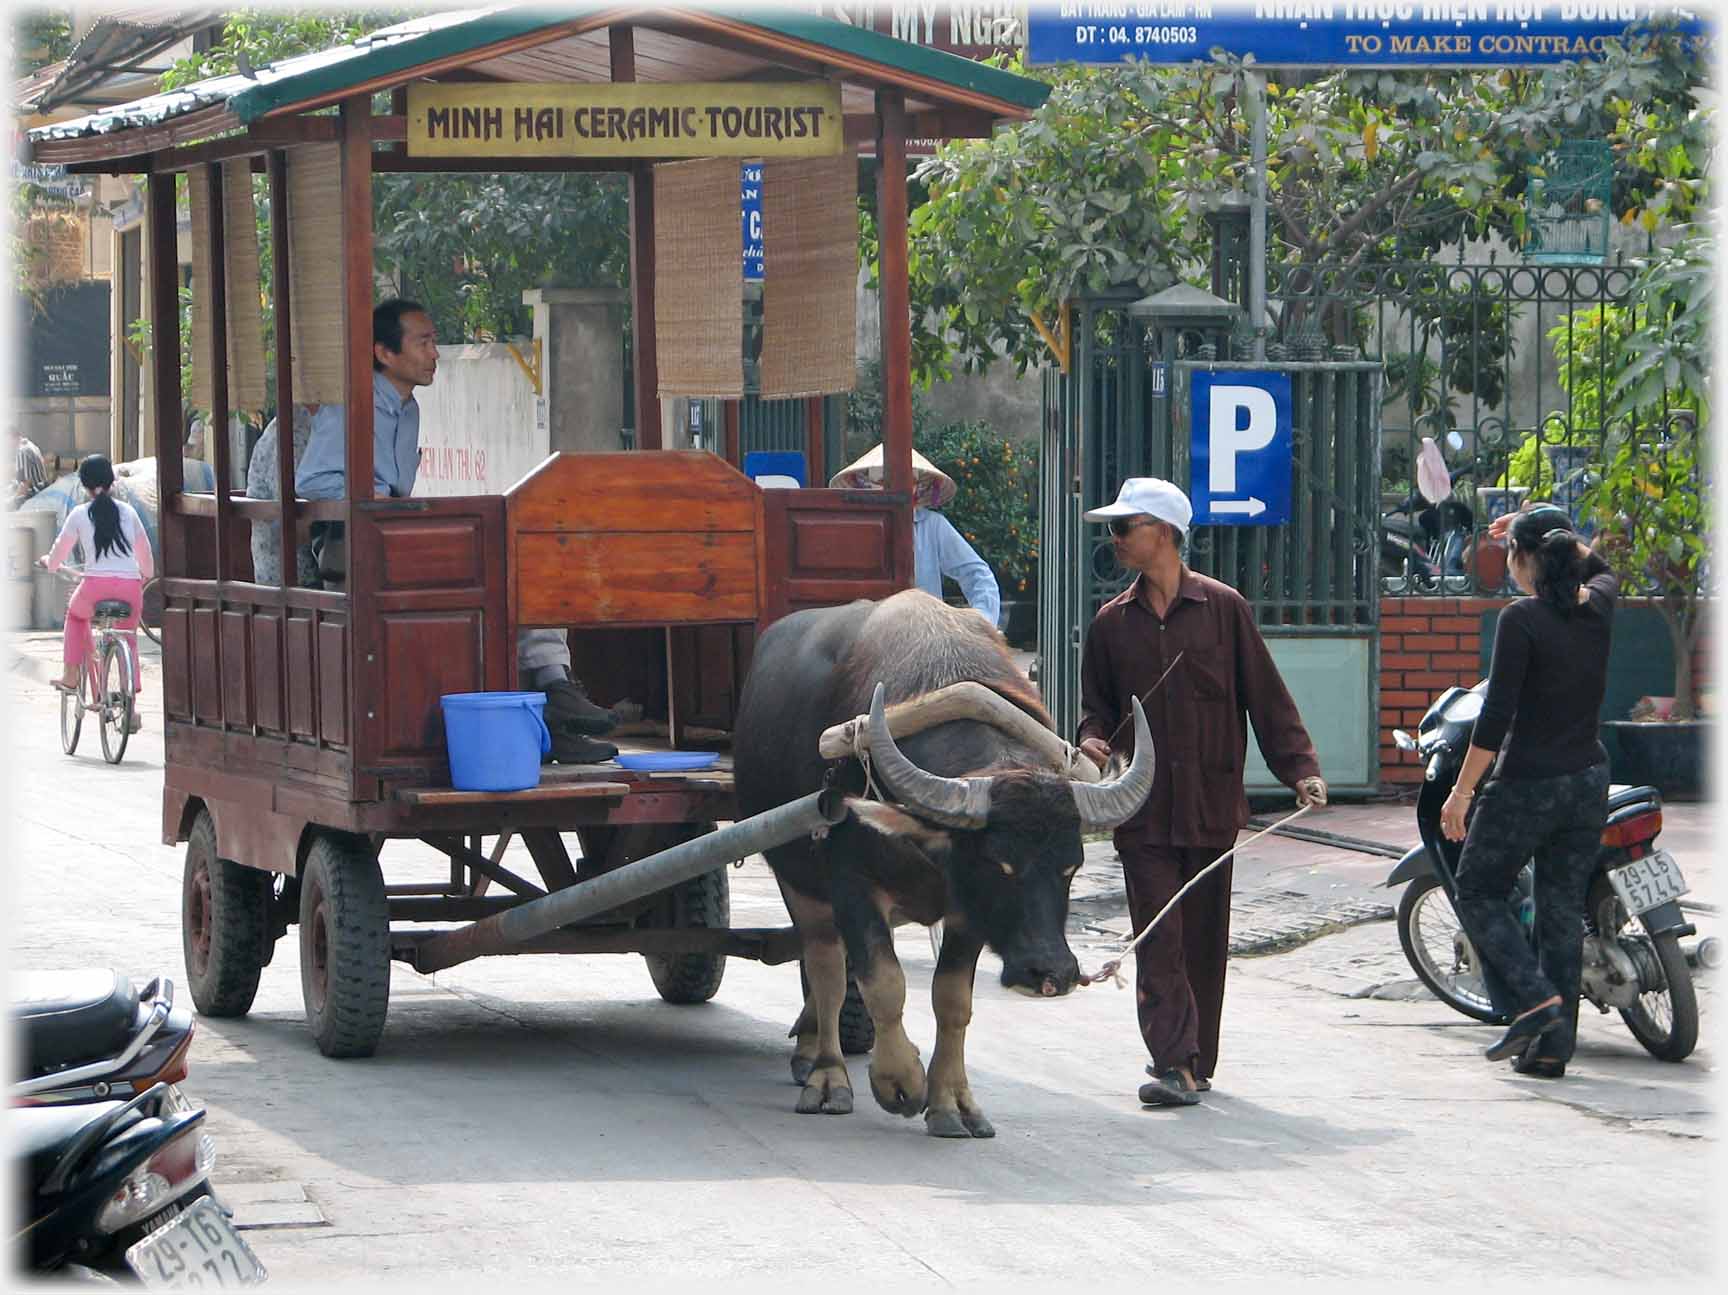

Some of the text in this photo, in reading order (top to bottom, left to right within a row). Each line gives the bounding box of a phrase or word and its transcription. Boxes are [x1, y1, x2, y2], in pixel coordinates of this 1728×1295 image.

[1135, 26, 1197, 43] 8740503
[1345, 35, 1382, 53] TO
[1389, 35, 1472, 53] MAKE
[427, 106, 825, 142] MINH HAI CERAMIC TOURIST
[1210, 385, 1277, 492] P
